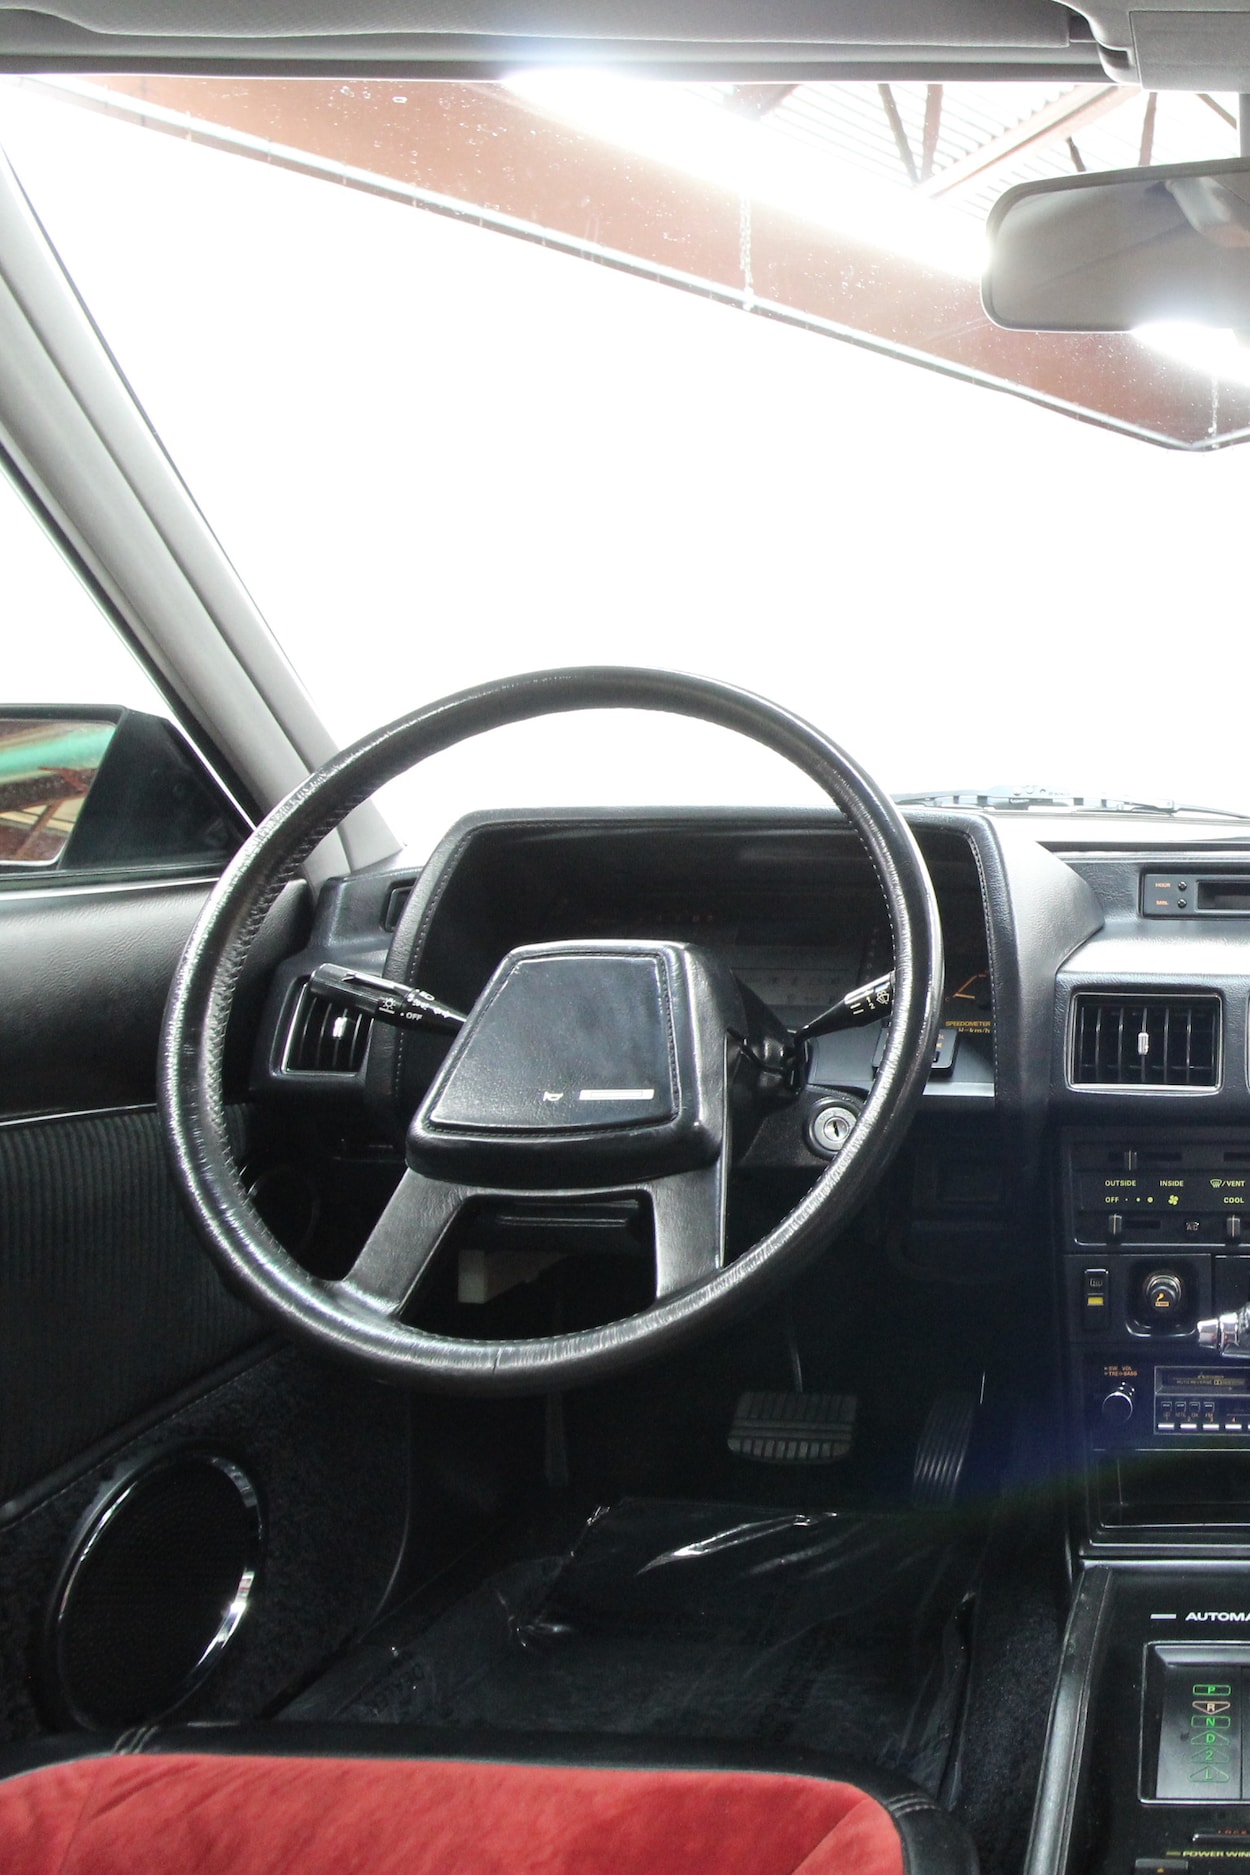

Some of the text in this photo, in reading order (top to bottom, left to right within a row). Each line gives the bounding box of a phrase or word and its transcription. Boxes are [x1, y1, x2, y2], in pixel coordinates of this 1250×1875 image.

[1154, 881, 1171, 889] HOUR
[405, 1011, 424, 1022] OFF
[945, 1020, 991, 1028] SPEEDOMETER
[1104, 1179, 1137, 1188] OUTSIDE
[1159, 1179, 1184, 1188] INSIDE
[1104, 1196, 1120, 1205] OFF
[1223, 1196, 1245, 1205] COOL
[1206, 1686, 1217, 1695] P
[1206, 1703, 1216, 1713] R
[1205, 1717, 1217, 1727] N
[1205, 1733, 1216, 1743] D
[1204, 1749, 1214, 1761] 2
[1204, 1771, 1213, 1780] L
[1182, 1849, 1224, 1859] POWER
